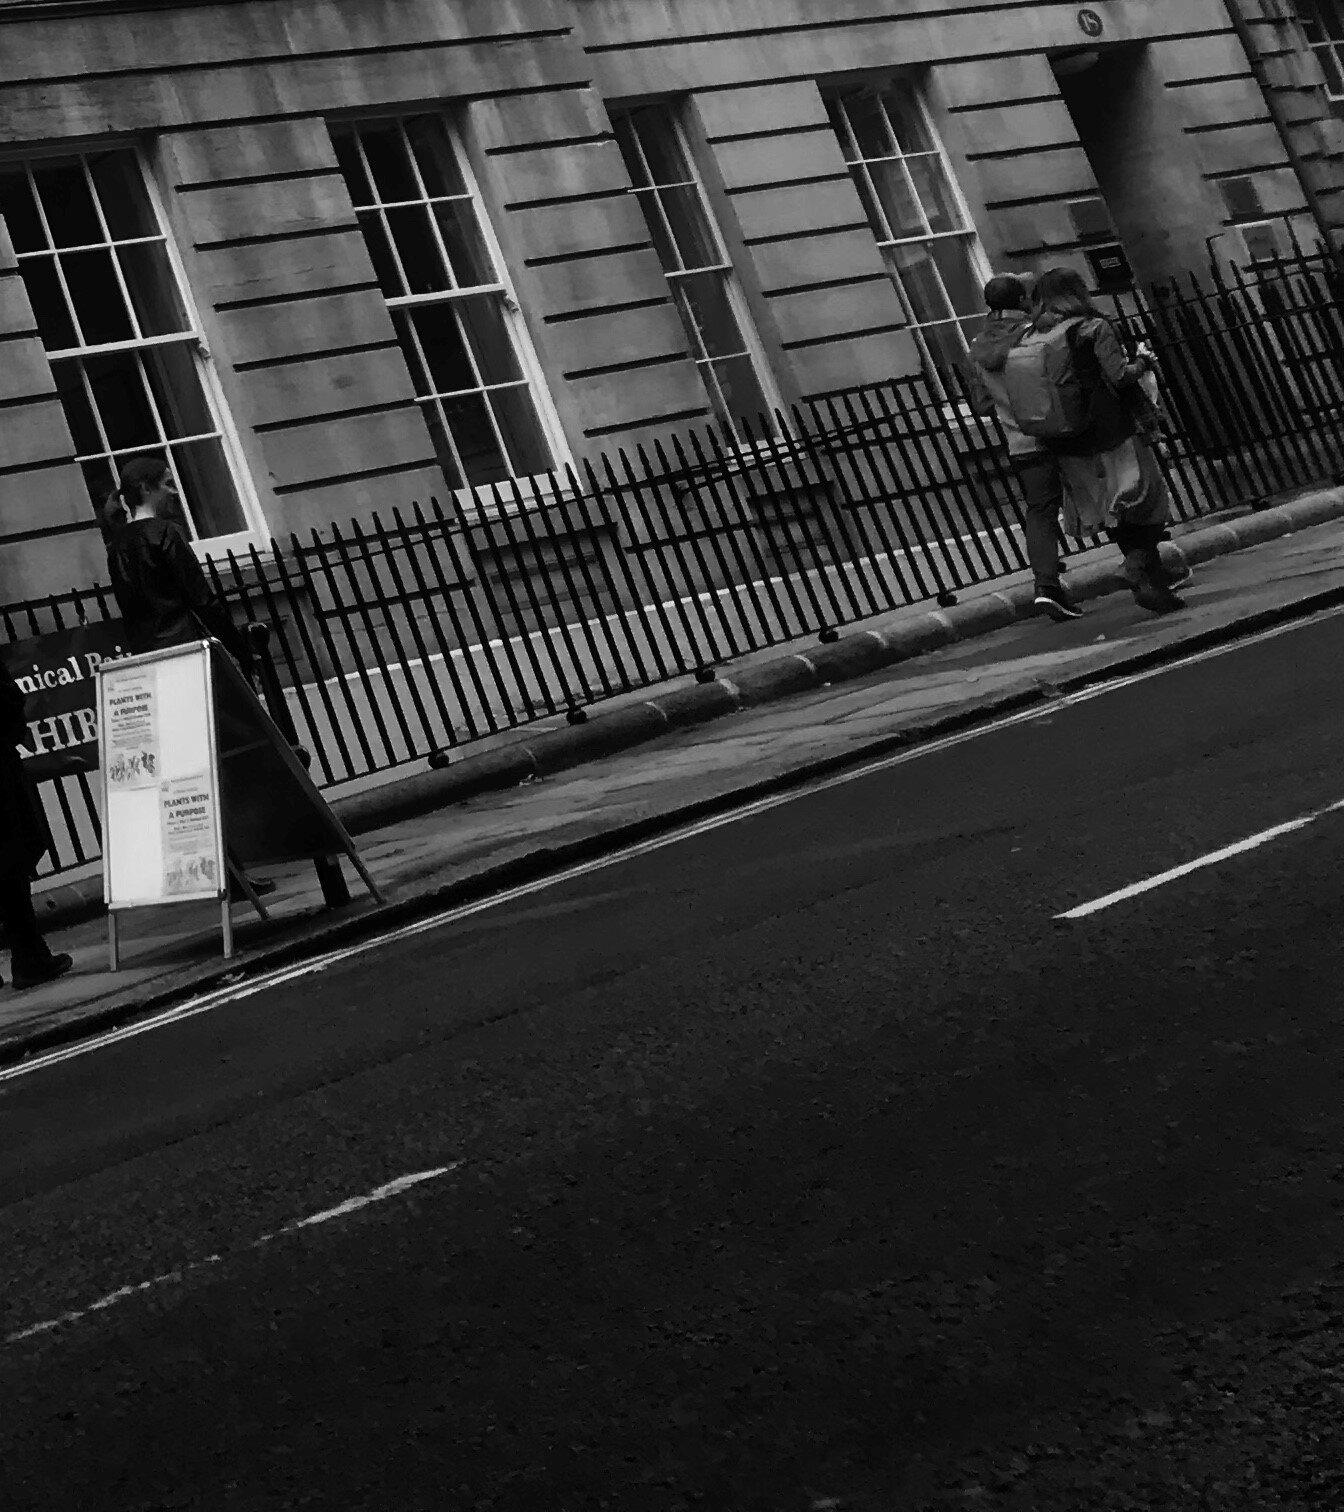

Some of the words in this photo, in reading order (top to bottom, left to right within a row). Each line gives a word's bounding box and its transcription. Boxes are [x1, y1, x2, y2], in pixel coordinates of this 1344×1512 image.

[14, 656, 84, 695] nical
[109, 695, 134, 706] PLANTS
[134, 692, 152, 701] WITH
[120, 704, 148, 716] PURPOSE
[15, 706, 99, 759] HIB
[163, 796, 190, 808] PLANTS
[190, 793, 210, 804] WITH
[175, 806, 206, 818] PURPOSE
